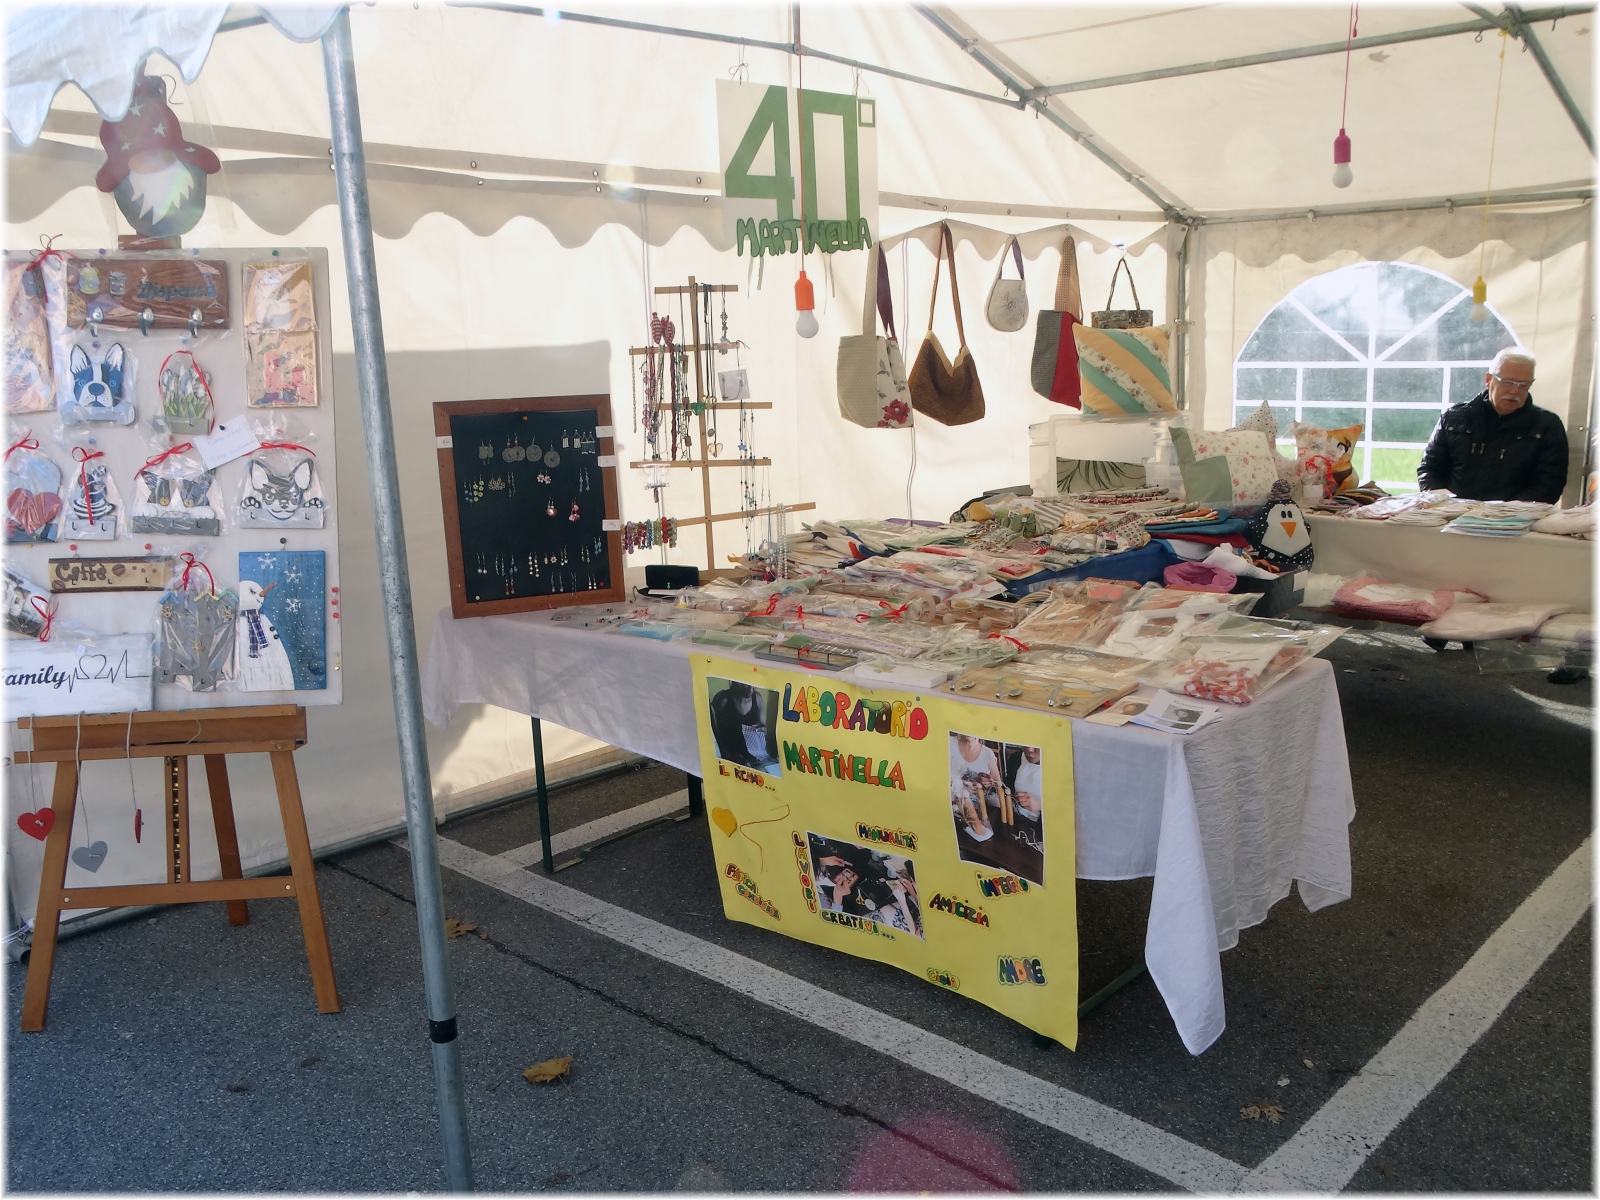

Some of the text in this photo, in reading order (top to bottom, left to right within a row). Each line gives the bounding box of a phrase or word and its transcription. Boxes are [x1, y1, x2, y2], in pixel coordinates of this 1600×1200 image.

[737, 217, 873, 257] MARTINELLA
[55, 562, 107, 582] Caffè
[3, 665, 67, 689] amily
[783, 683, 928, 740] LABORATORIO
[783, 740, 906, 791] MARTINELLA
[793, 832, 815, 911] LAVORI
[929, 893, 990, 928] AMICIZIA
